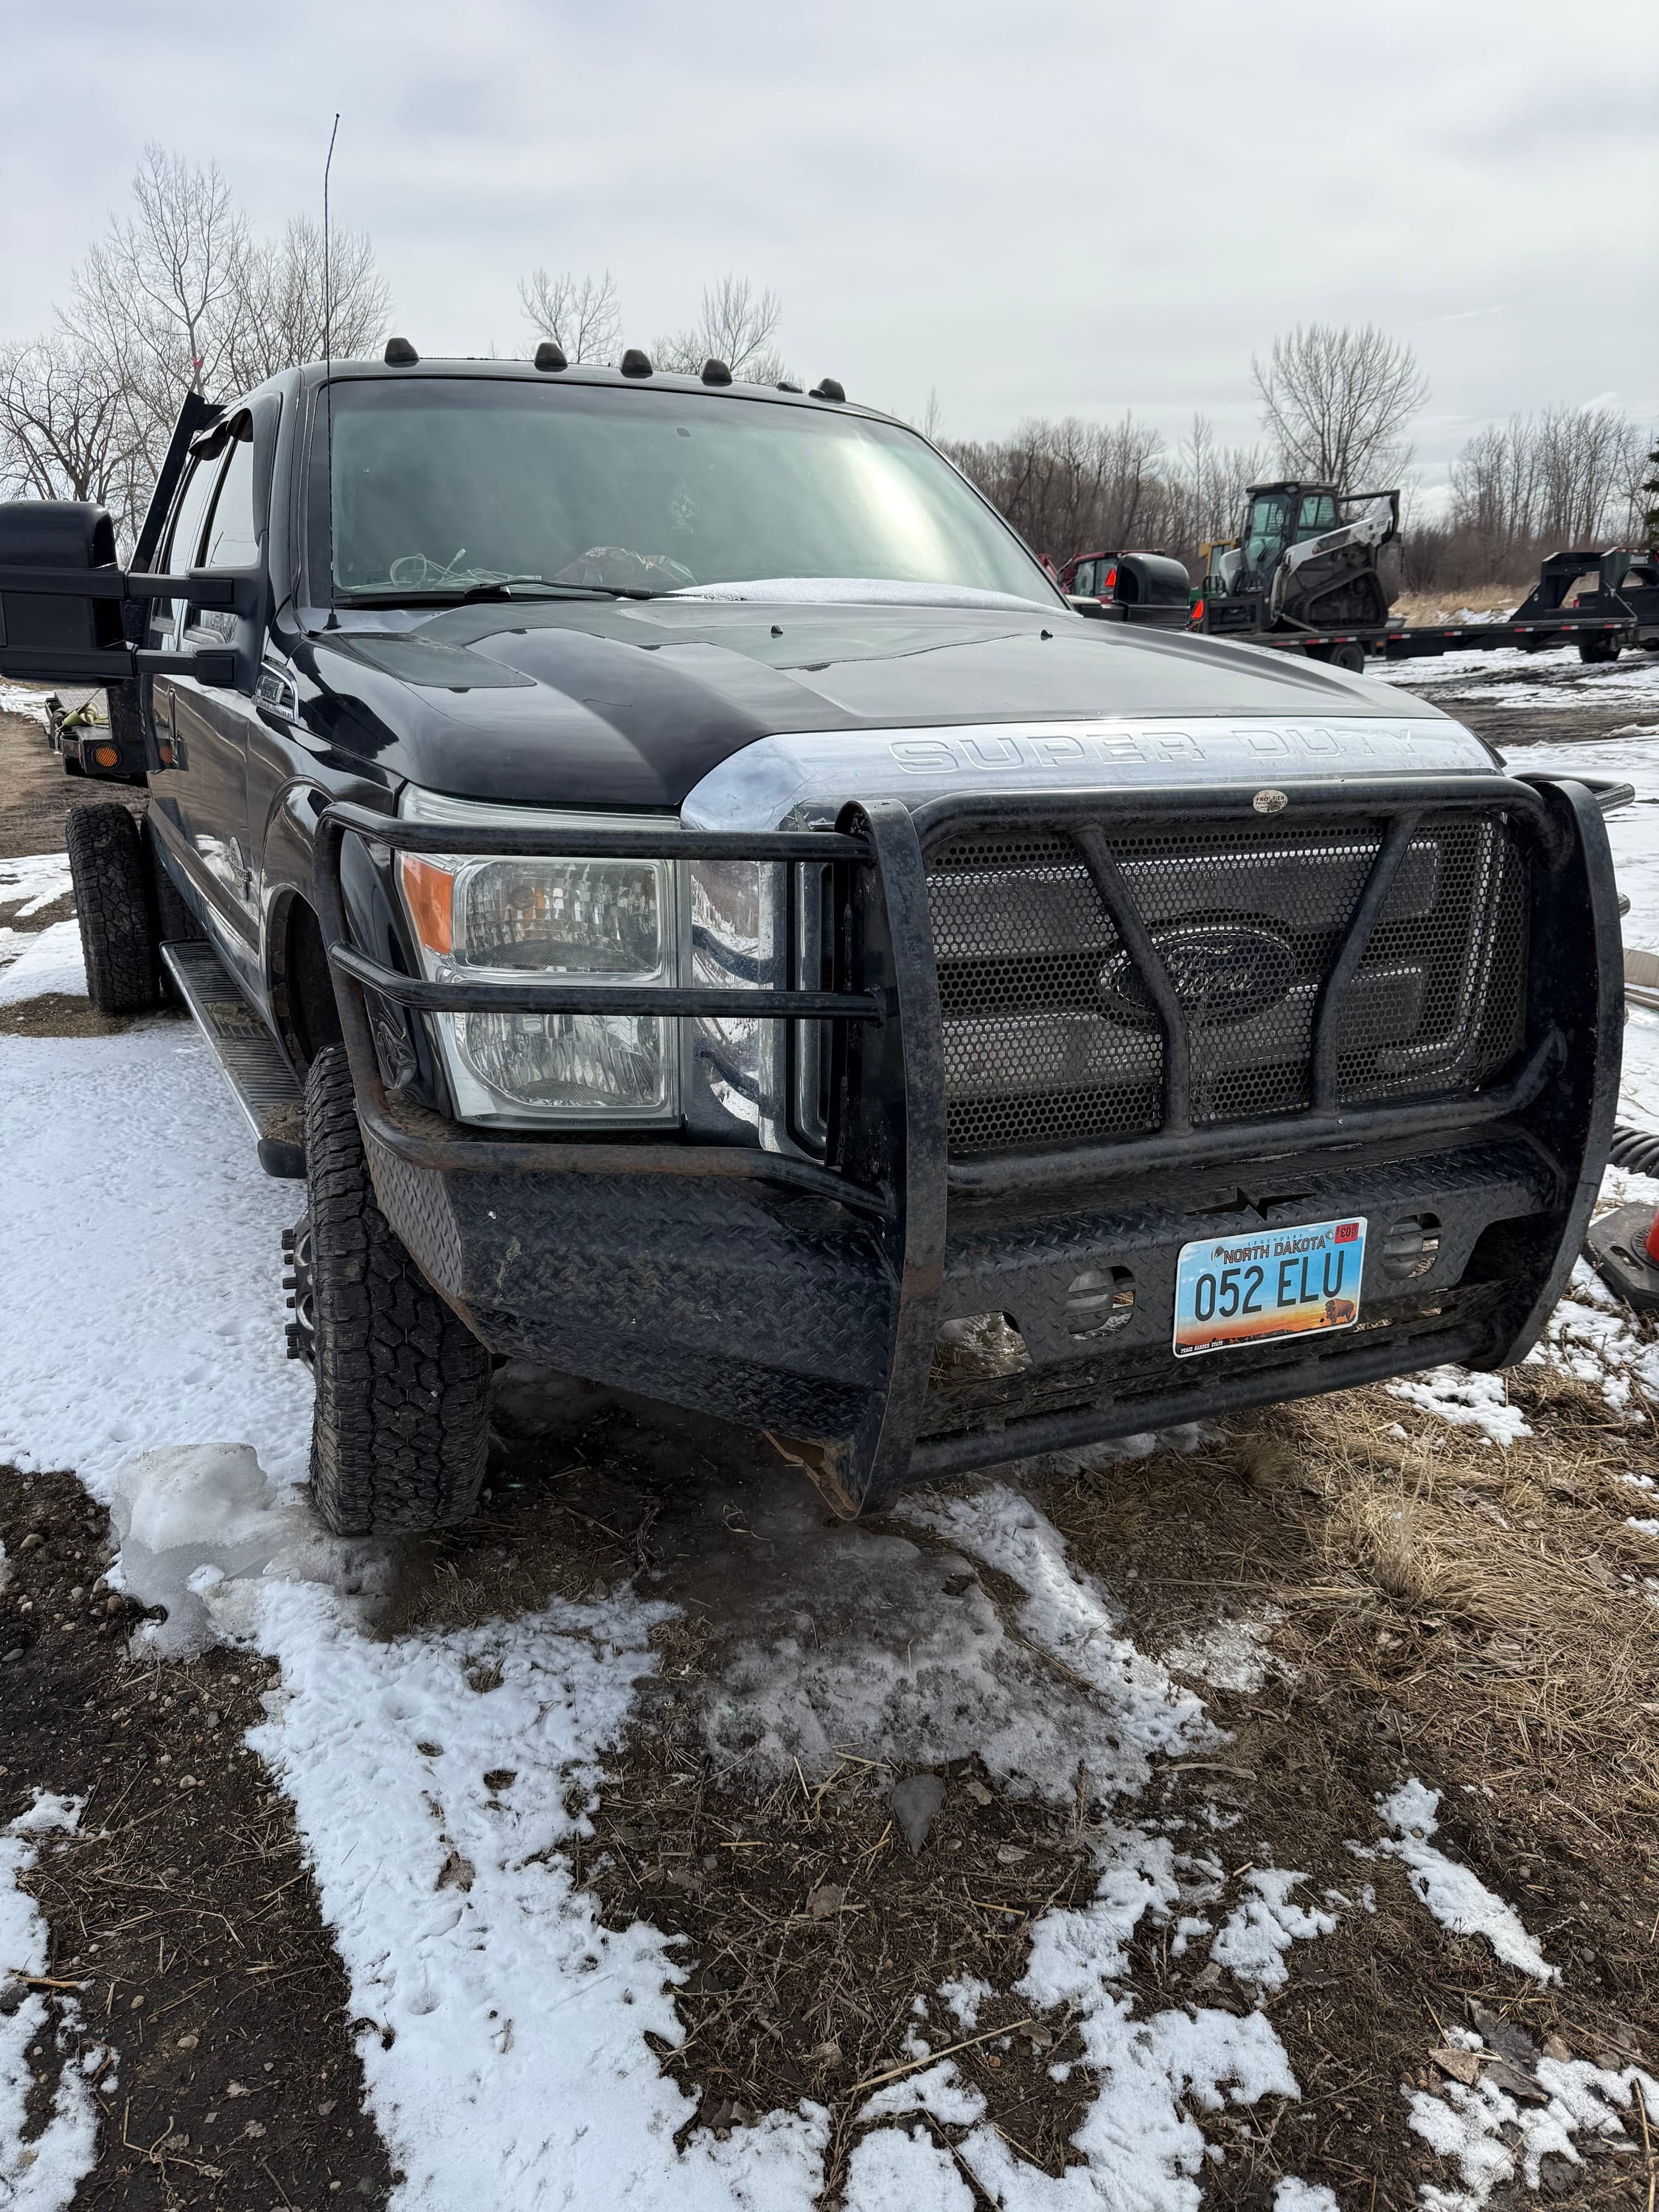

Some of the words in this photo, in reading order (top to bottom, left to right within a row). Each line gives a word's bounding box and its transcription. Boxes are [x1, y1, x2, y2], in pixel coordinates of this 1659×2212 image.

[888, 731, 1206, 774] SUPER
[1231, 728, 1416, 759] DUTY
[1223, 1244, 1270, 1265] NORTH
[1273, 1235, 1326, 1256] DAKOTA
[1248, 1234, 1302, 1247] LEGENDARY
[1194, 1265, 1265, 1321] 052
[1277, 1250, 1344, 1307] ELU
